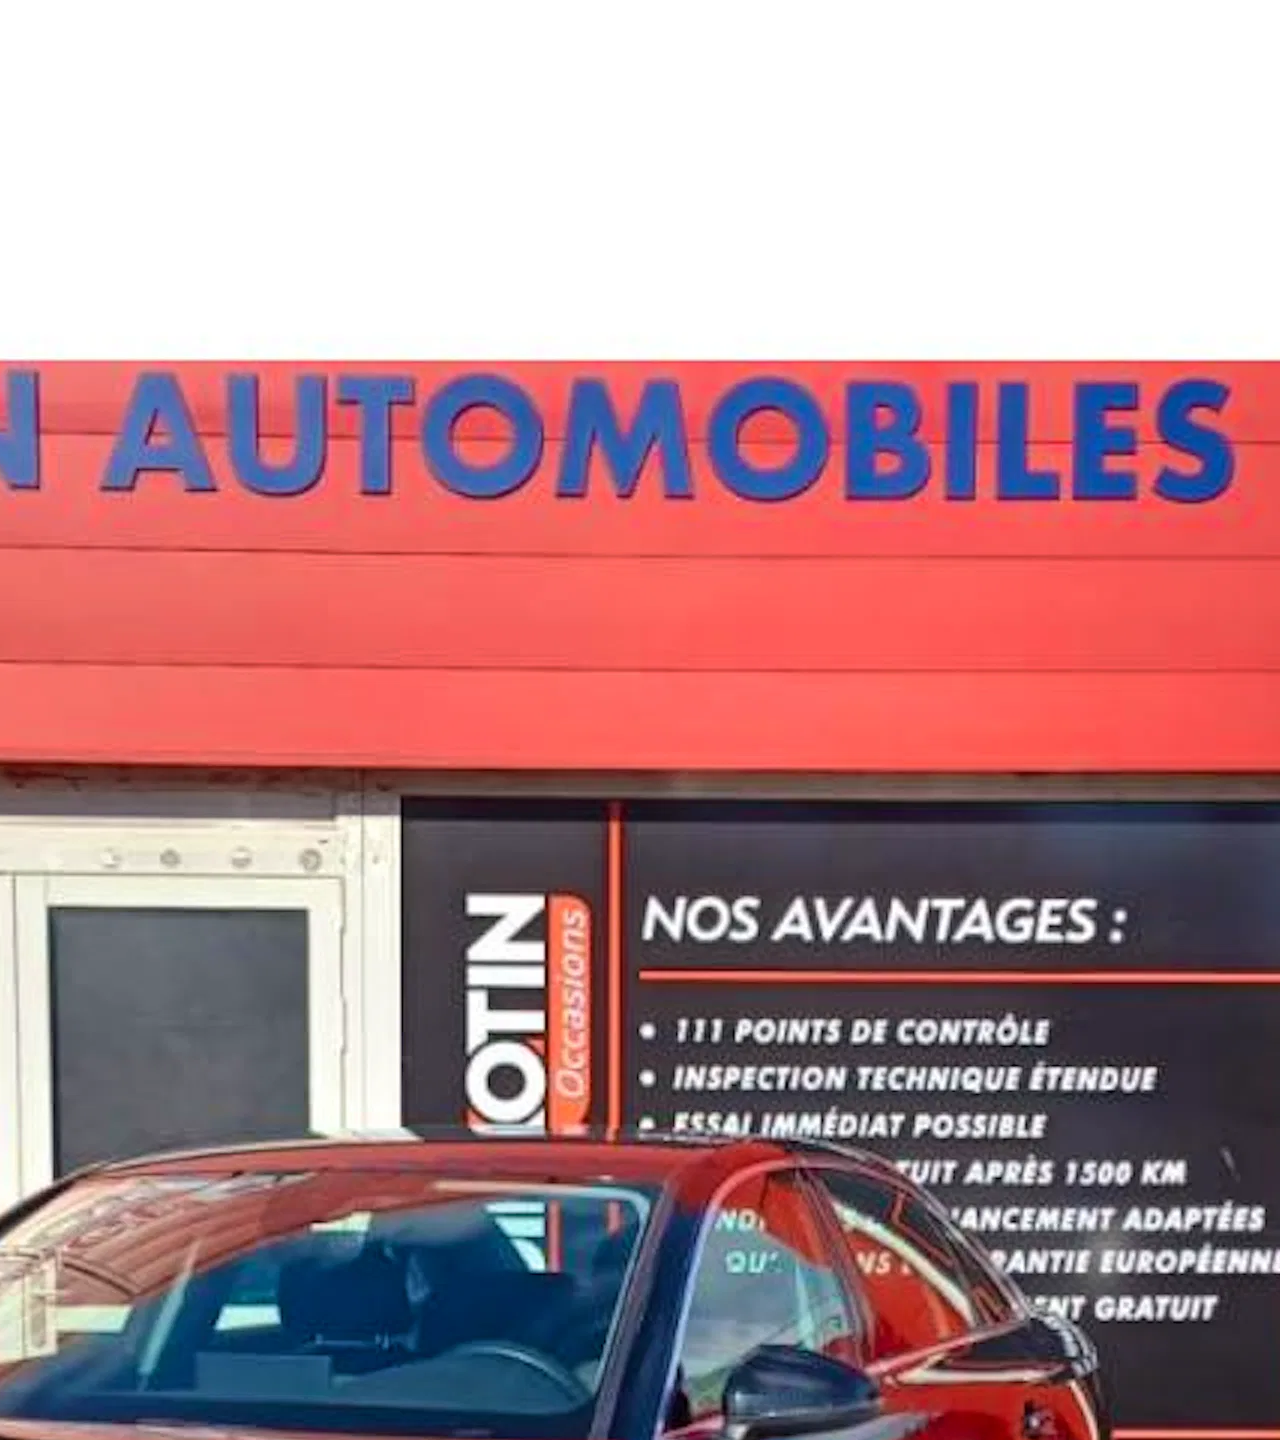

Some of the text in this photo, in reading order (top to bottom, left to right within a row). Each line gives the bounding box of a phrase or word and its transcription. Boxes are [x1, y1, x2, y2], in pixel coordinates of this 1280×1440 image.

[100, 370, 1237, 505] AUTOMOBILES
[641, 896, 761, 944] NOS
[771, 896, 1098, 945] AVANTAGES
[556, 907, 587, 1099] Occasions
[674, 1014, 1051, 1046] 111 POINTS DE CONTRÔLE
[672, 1061, 1159, 1092] INSPECTION TECHNIQUE ÉTENDUE
[673, 1106, 1049, 1139] ESSAI IMMÉDIAT POSSIBLE
[963, 1154, 1054, 1185] APRÈS
[1065, 1160, 1131, 1185] 1500
[1141, 1160, 1188, 1185] KM
[950, 1201, 1267, 1232] ANCEMENT ADAPTÉES
[1094, 1295, 1219, 1322] GRATUIT
